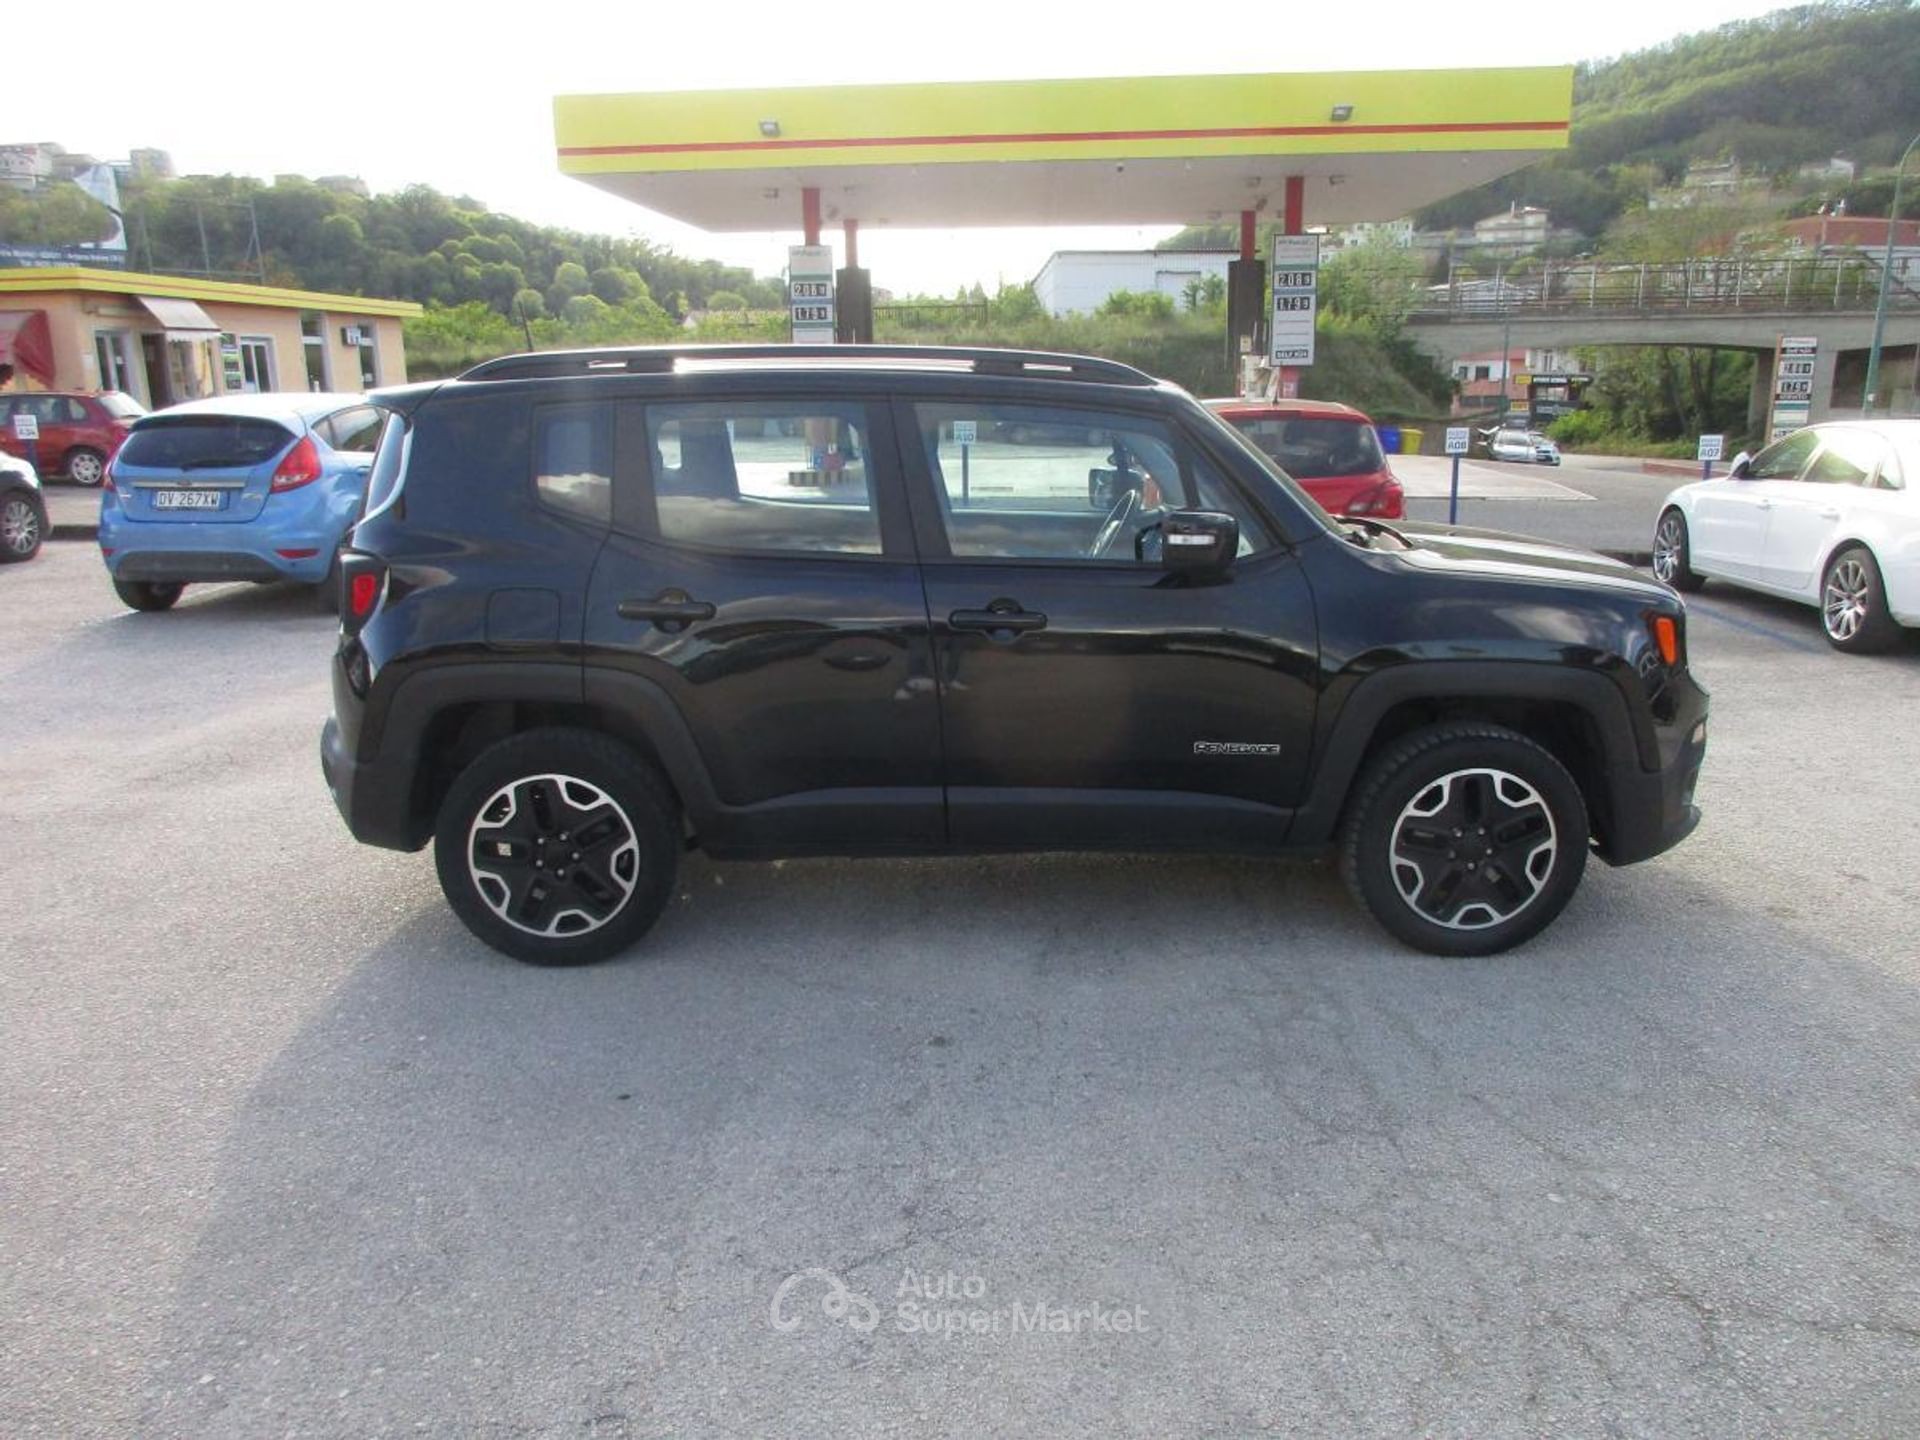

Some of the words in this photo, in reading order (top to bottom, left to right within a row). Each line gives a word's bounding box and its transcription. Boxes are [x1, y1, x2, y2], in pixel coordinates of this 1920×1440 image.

[158, 491, 173, 506] DV
[179, 491, 219, 506] 267XW
[1194, 741, 1280, 755] RENEGADE
